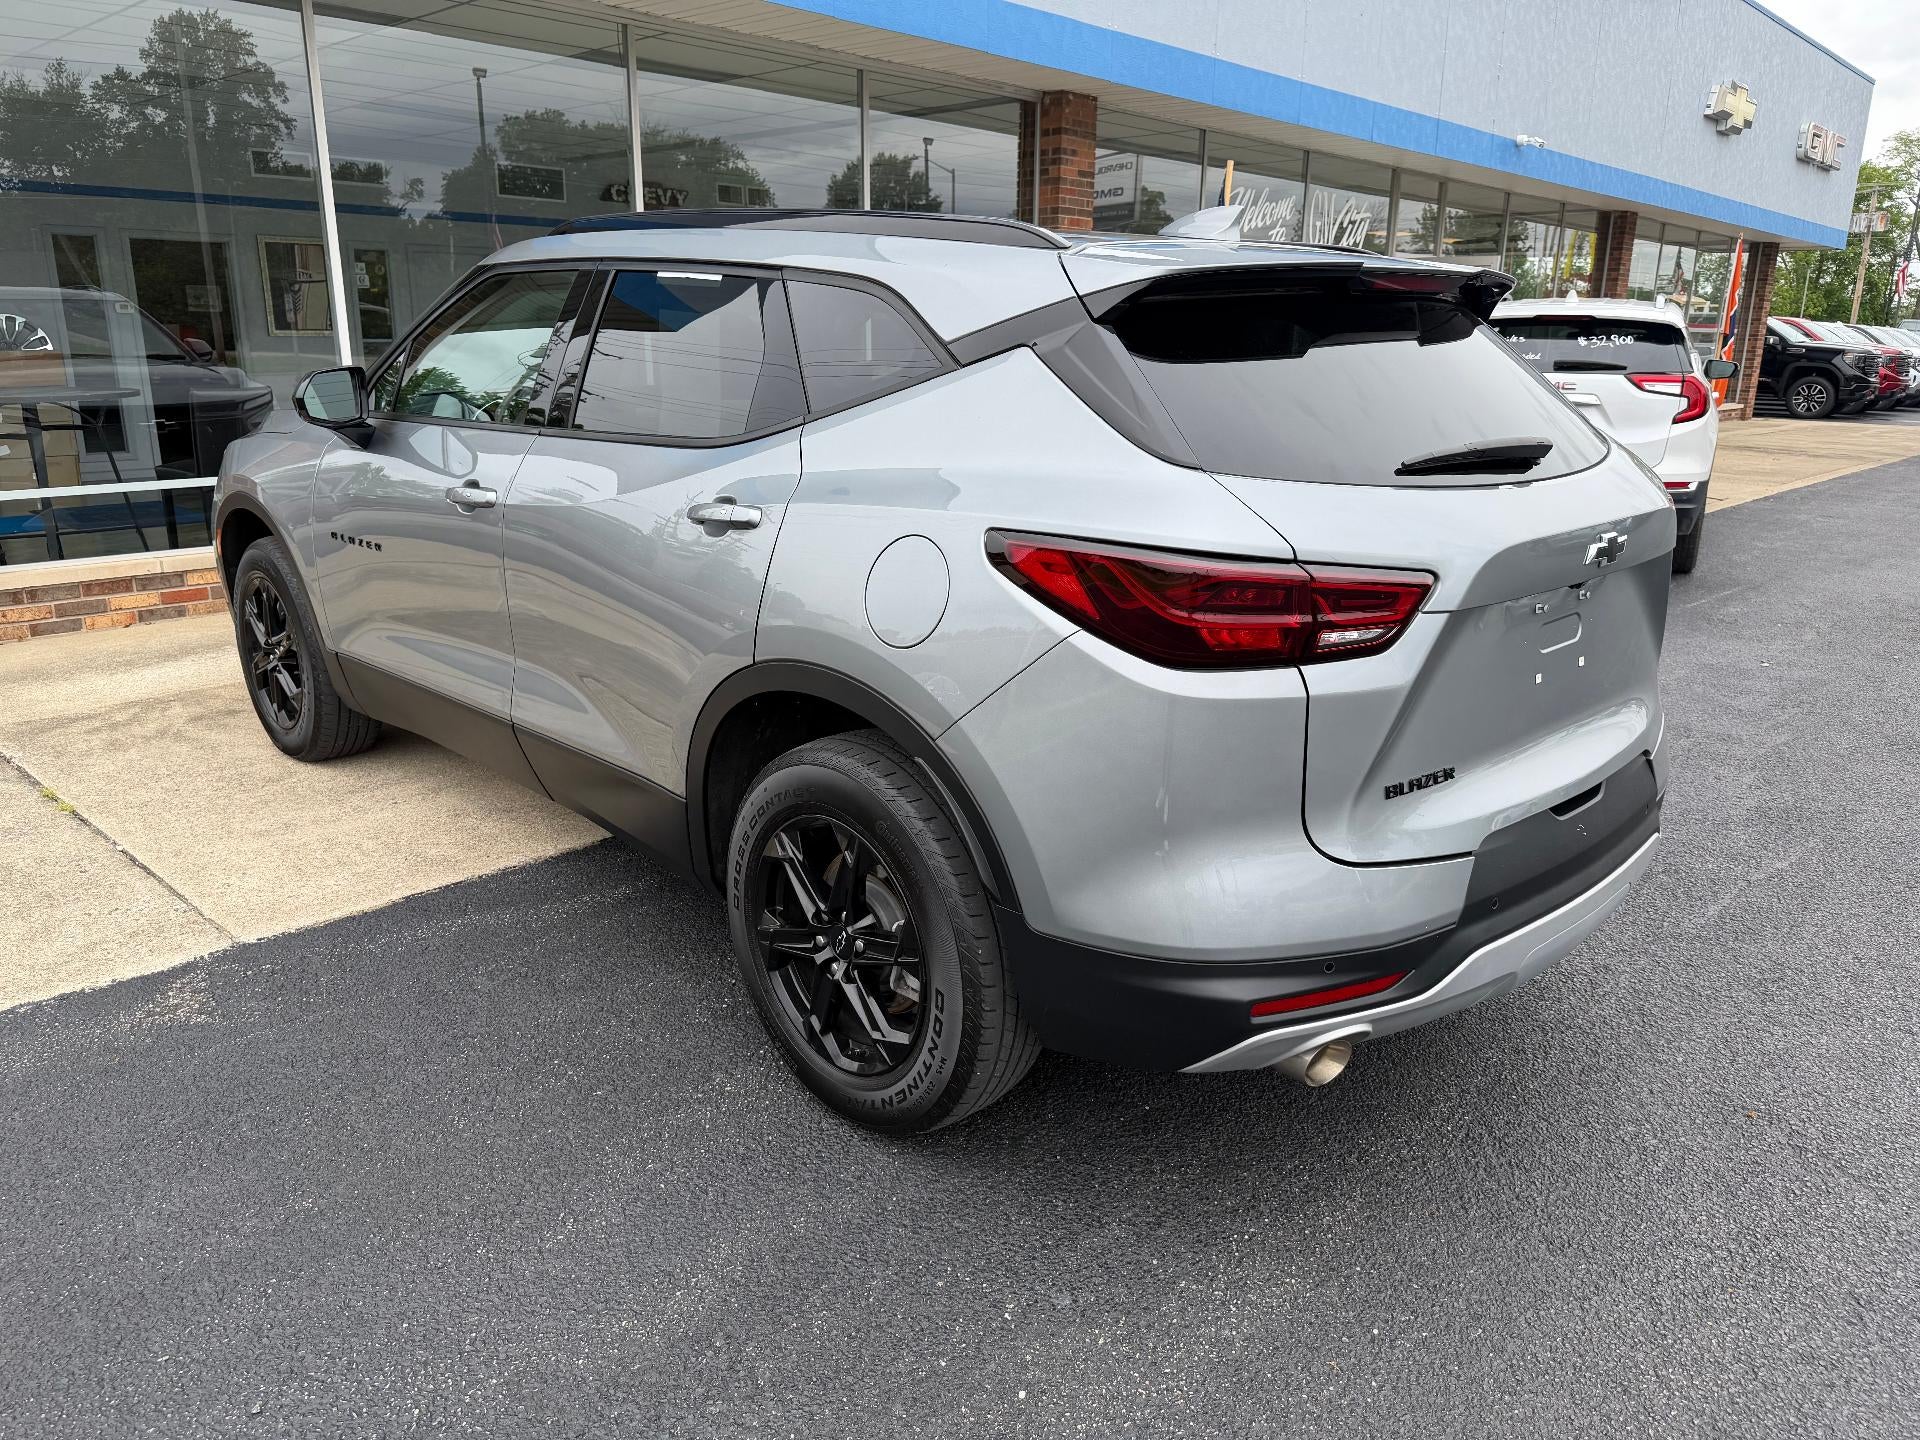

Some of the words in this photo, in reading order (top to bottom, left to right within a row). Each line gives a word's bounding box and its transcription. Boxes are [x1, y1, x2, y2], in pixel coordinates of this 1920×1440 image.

[1802, 123, 1847, 171] GMC
[610, 184, 688, 206] CEVY
[1230, 186, 1296, 233] Welcome
[1268, 218, 1287, 242] to
[1332, 197, 1373, 249] City
[1577, 335, 1634, 348] $32,900
[330, 531, 383, 553] BLAZER
[1384, 766, 1456, 800] BLAZER
[848, 987, 945, 1111] CONTINENTAL
